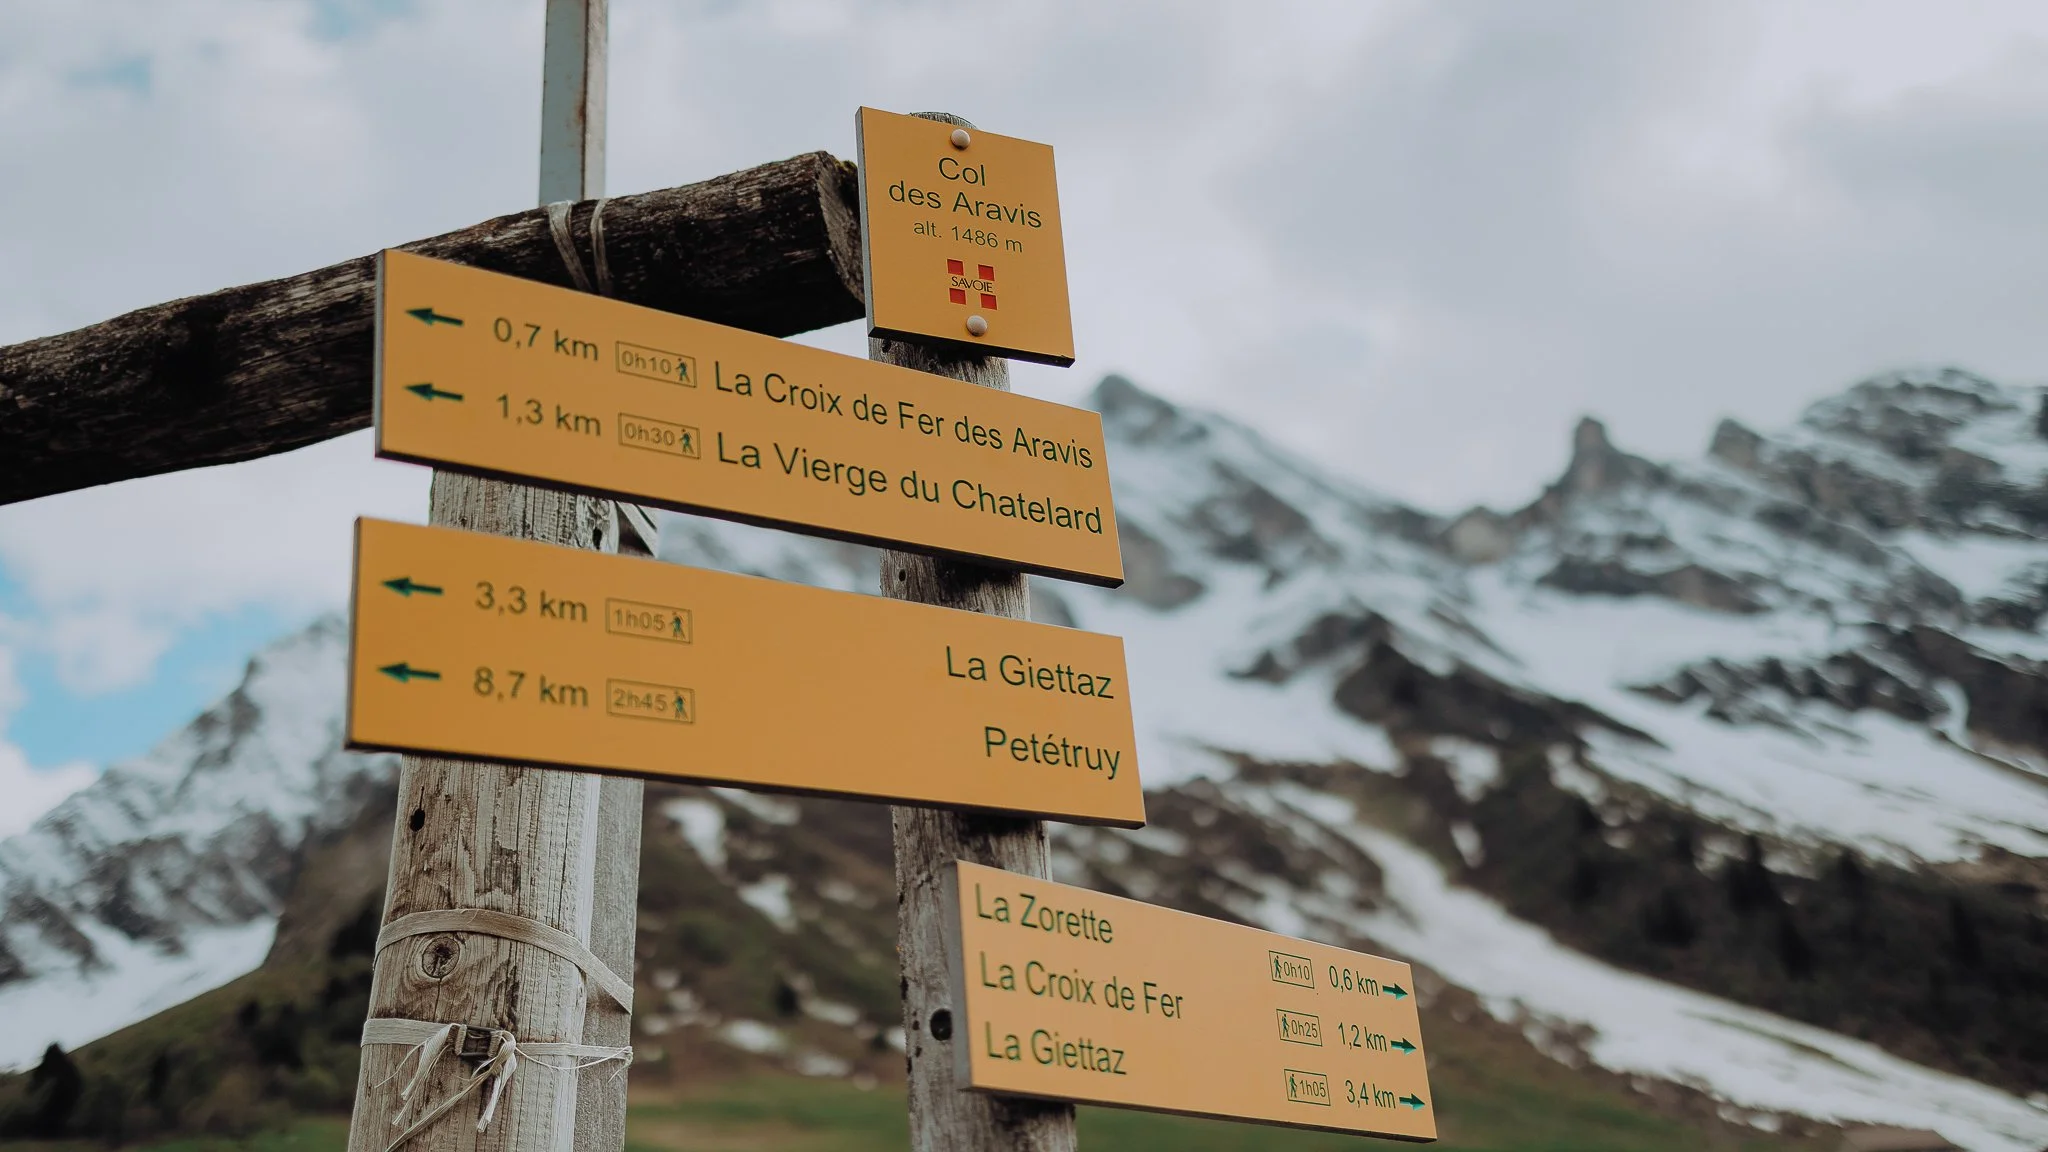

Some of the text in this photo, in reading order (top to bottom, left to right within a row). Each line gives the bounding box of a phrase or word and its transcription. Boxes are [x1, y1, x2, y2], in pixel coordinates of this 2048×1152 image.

[888, 181, 1042, 228] des Aravis
[938, 157, 986, 186] Col
[913, 220, 1023, 253] alt. 1486 m
[951, 276, 993, 293] SAVOIE
[494, 317, 1093, 469] 0,7 km 0h10 La Croix de Fer des Aravis
[497, 394, 1103, 535] 1,3 km 0h30 La Vierge du Chatelard
[474, 581, 1114, 699] 3,3 km 1h05 La Giettaz
[473, 667, 1120, 780] 8,7 km 2h45 Petétruy
[975, 883, 1379, 996] La Zorette 0h10 0,6 km
[980, 951, 1387, 1052] La Croix de Fer 0h25 1,2 km
[985, 1021, 1395, 1109] La Giettaz 1h05 3,4 km
